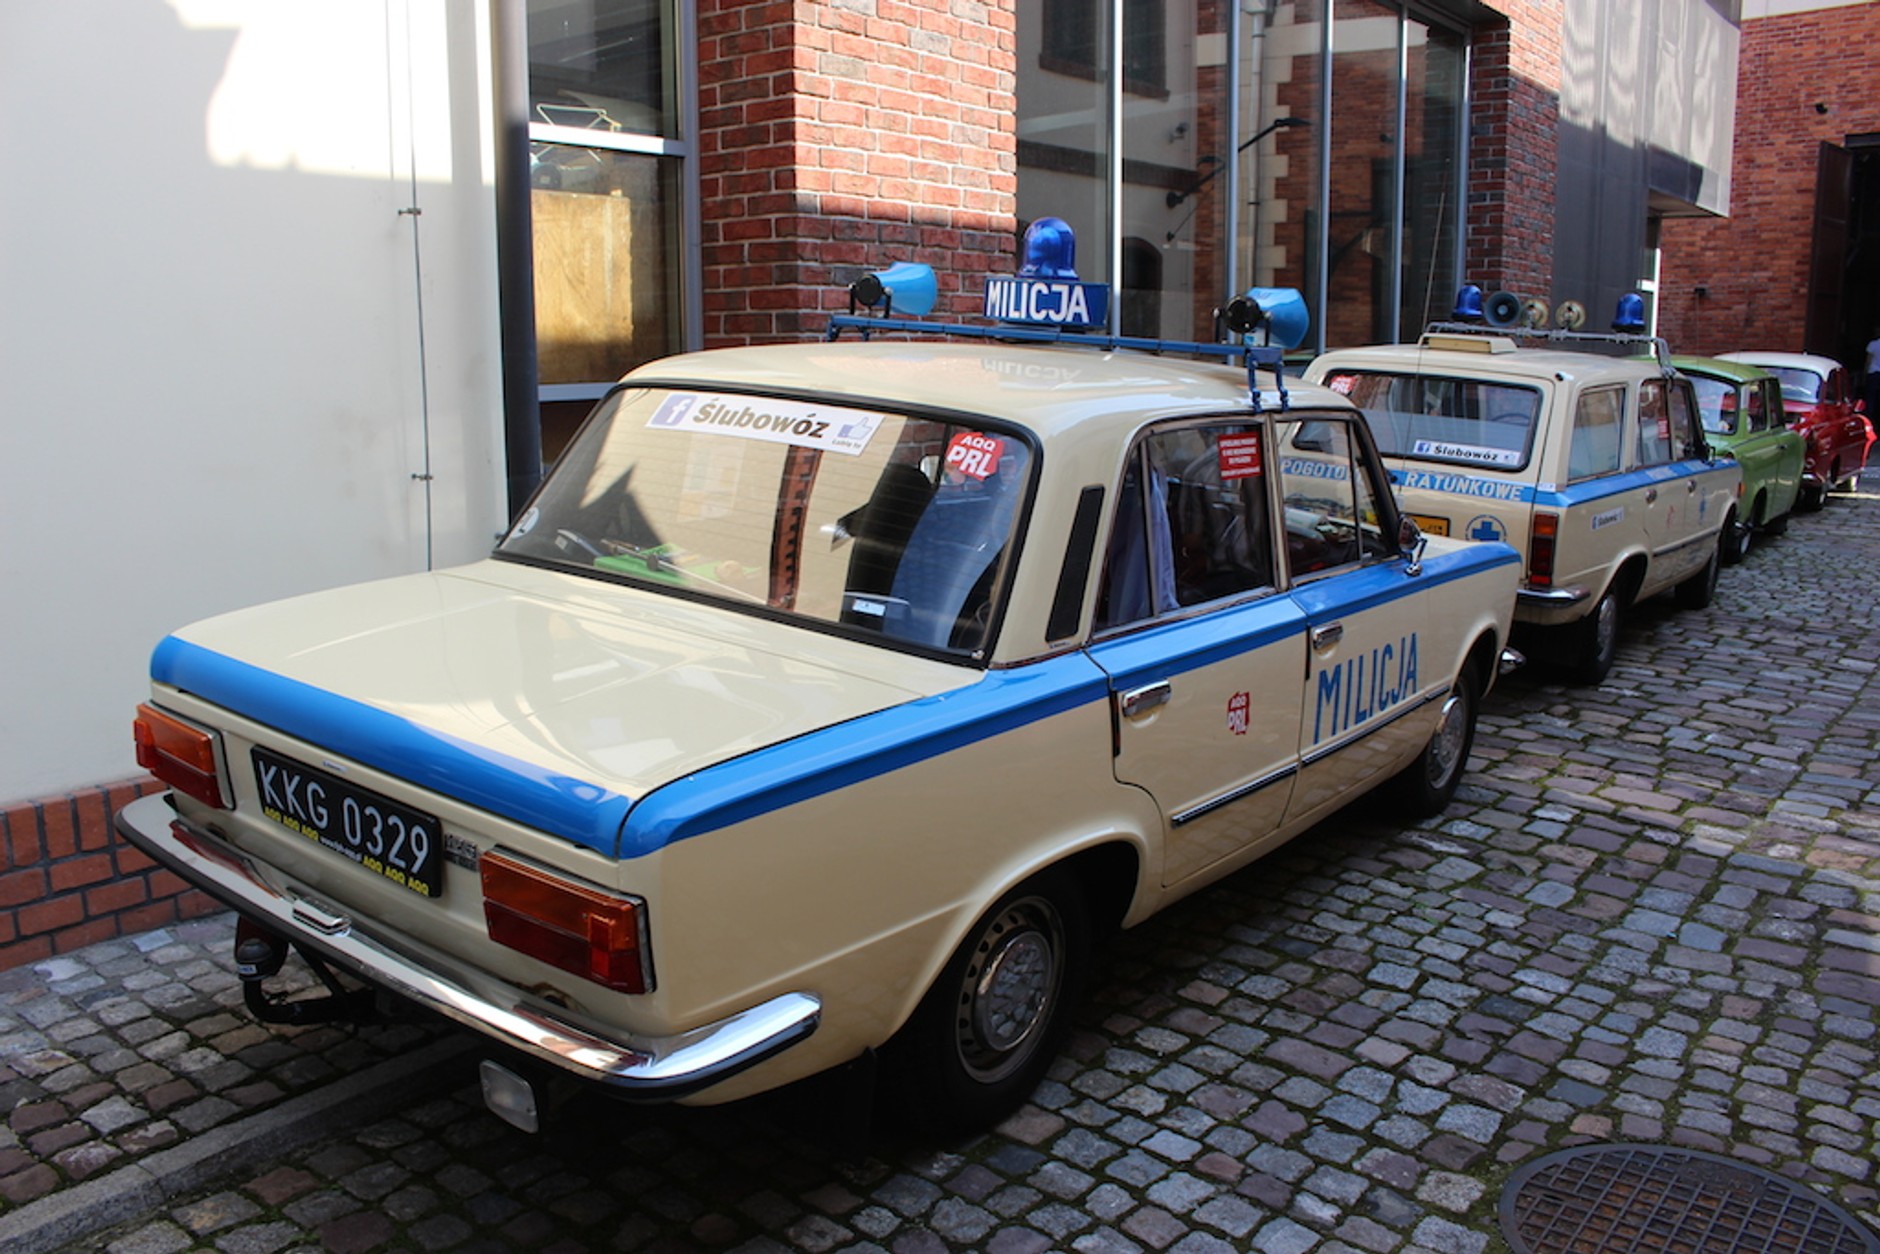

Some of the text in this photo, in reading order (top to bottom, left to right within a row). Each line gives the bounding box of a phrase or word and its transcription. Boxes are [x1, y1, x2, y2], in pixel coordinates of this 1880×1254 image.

[986, 280, 1090, 323] MILICJA
[692, 398, 831, 438] Ślubowóz
[947, 445, 992, 477] PRL
[960, 435, 996, 453] AQQ
[1280, 459, 1362, 481] POGOTO
[1404, 470, 1524, 501] RATUNKOWE
[1313, 632, 1417, 745] MILICJA
[1227, 708, 1247, 733] PRL
[259, 760, 328, 829] KKG
[343, 797, 429, 874] 0329
[363, 855, 383, 875] AQQ
[385, 866, 406, 886] AQQ
[408, 877, 429, 897] AQQ
